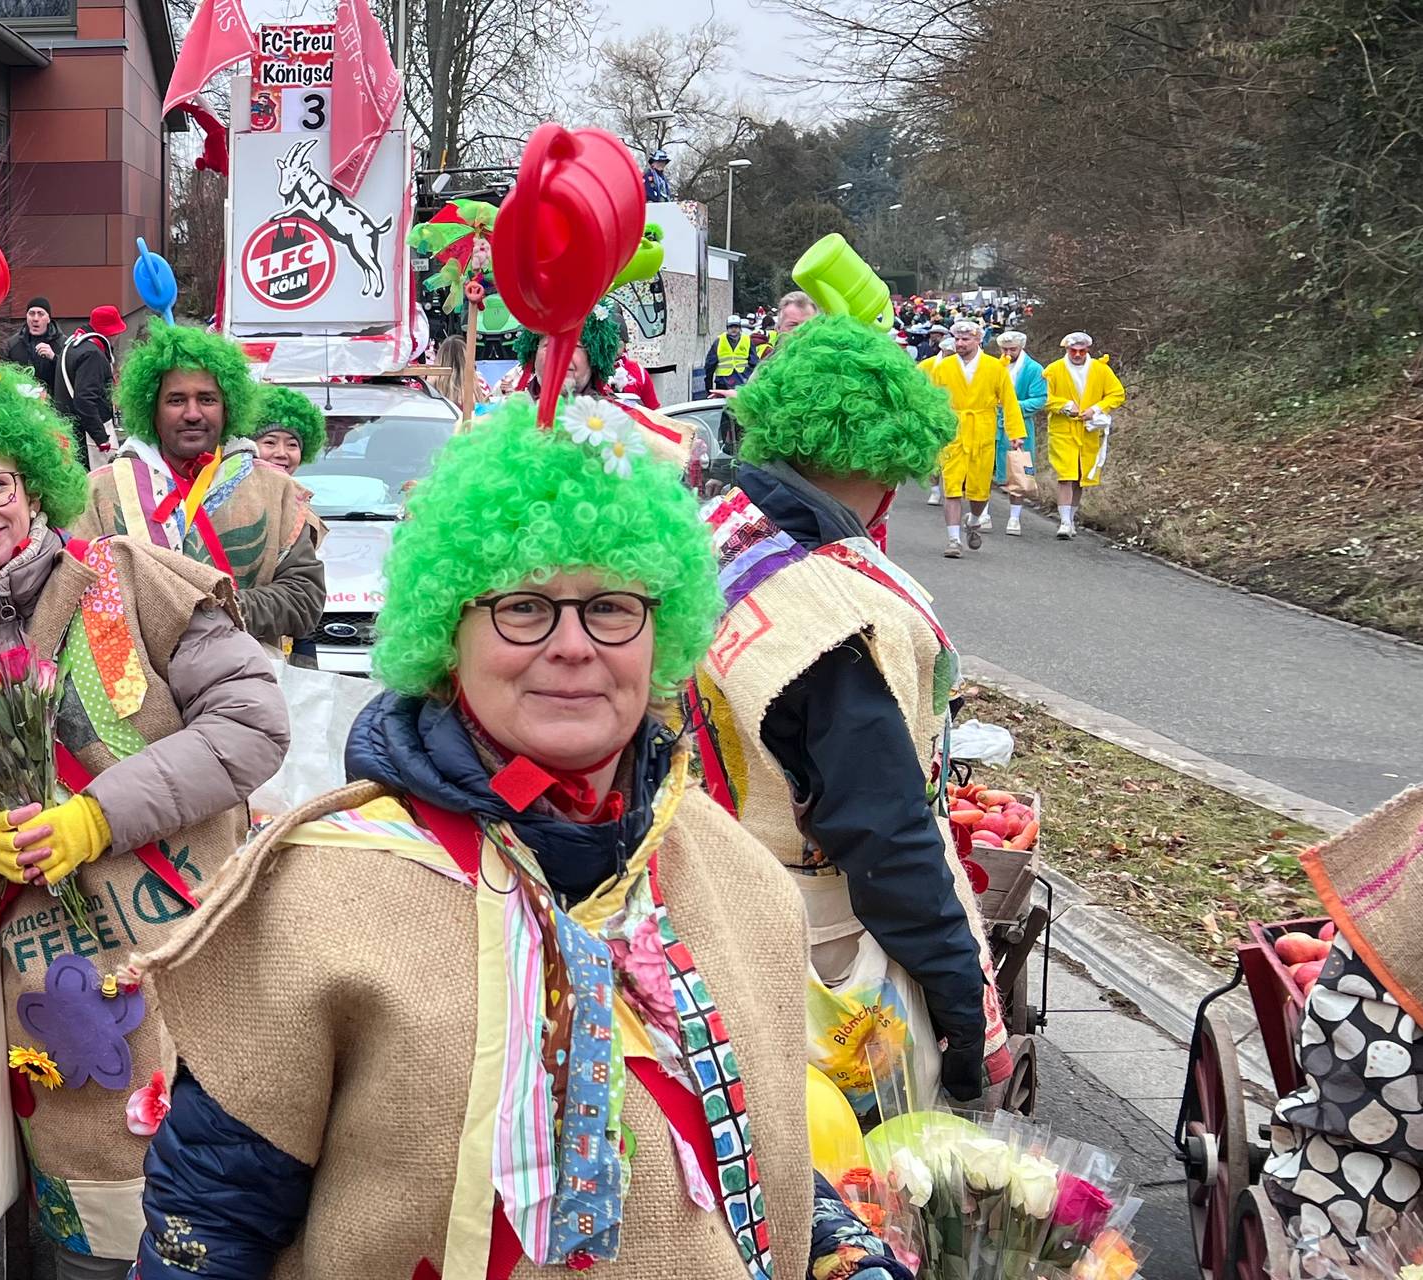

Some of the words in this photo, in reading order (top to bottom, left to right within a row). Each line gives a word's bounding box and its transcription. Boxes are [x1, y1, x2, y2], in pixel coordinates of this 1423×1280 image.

[261, 31, 335, 53] FC-Freu
[302, 93, 325, 130] 3
[269, 272, 308, 296] KÖLN
[4, 915, 121, 973] FFEE
